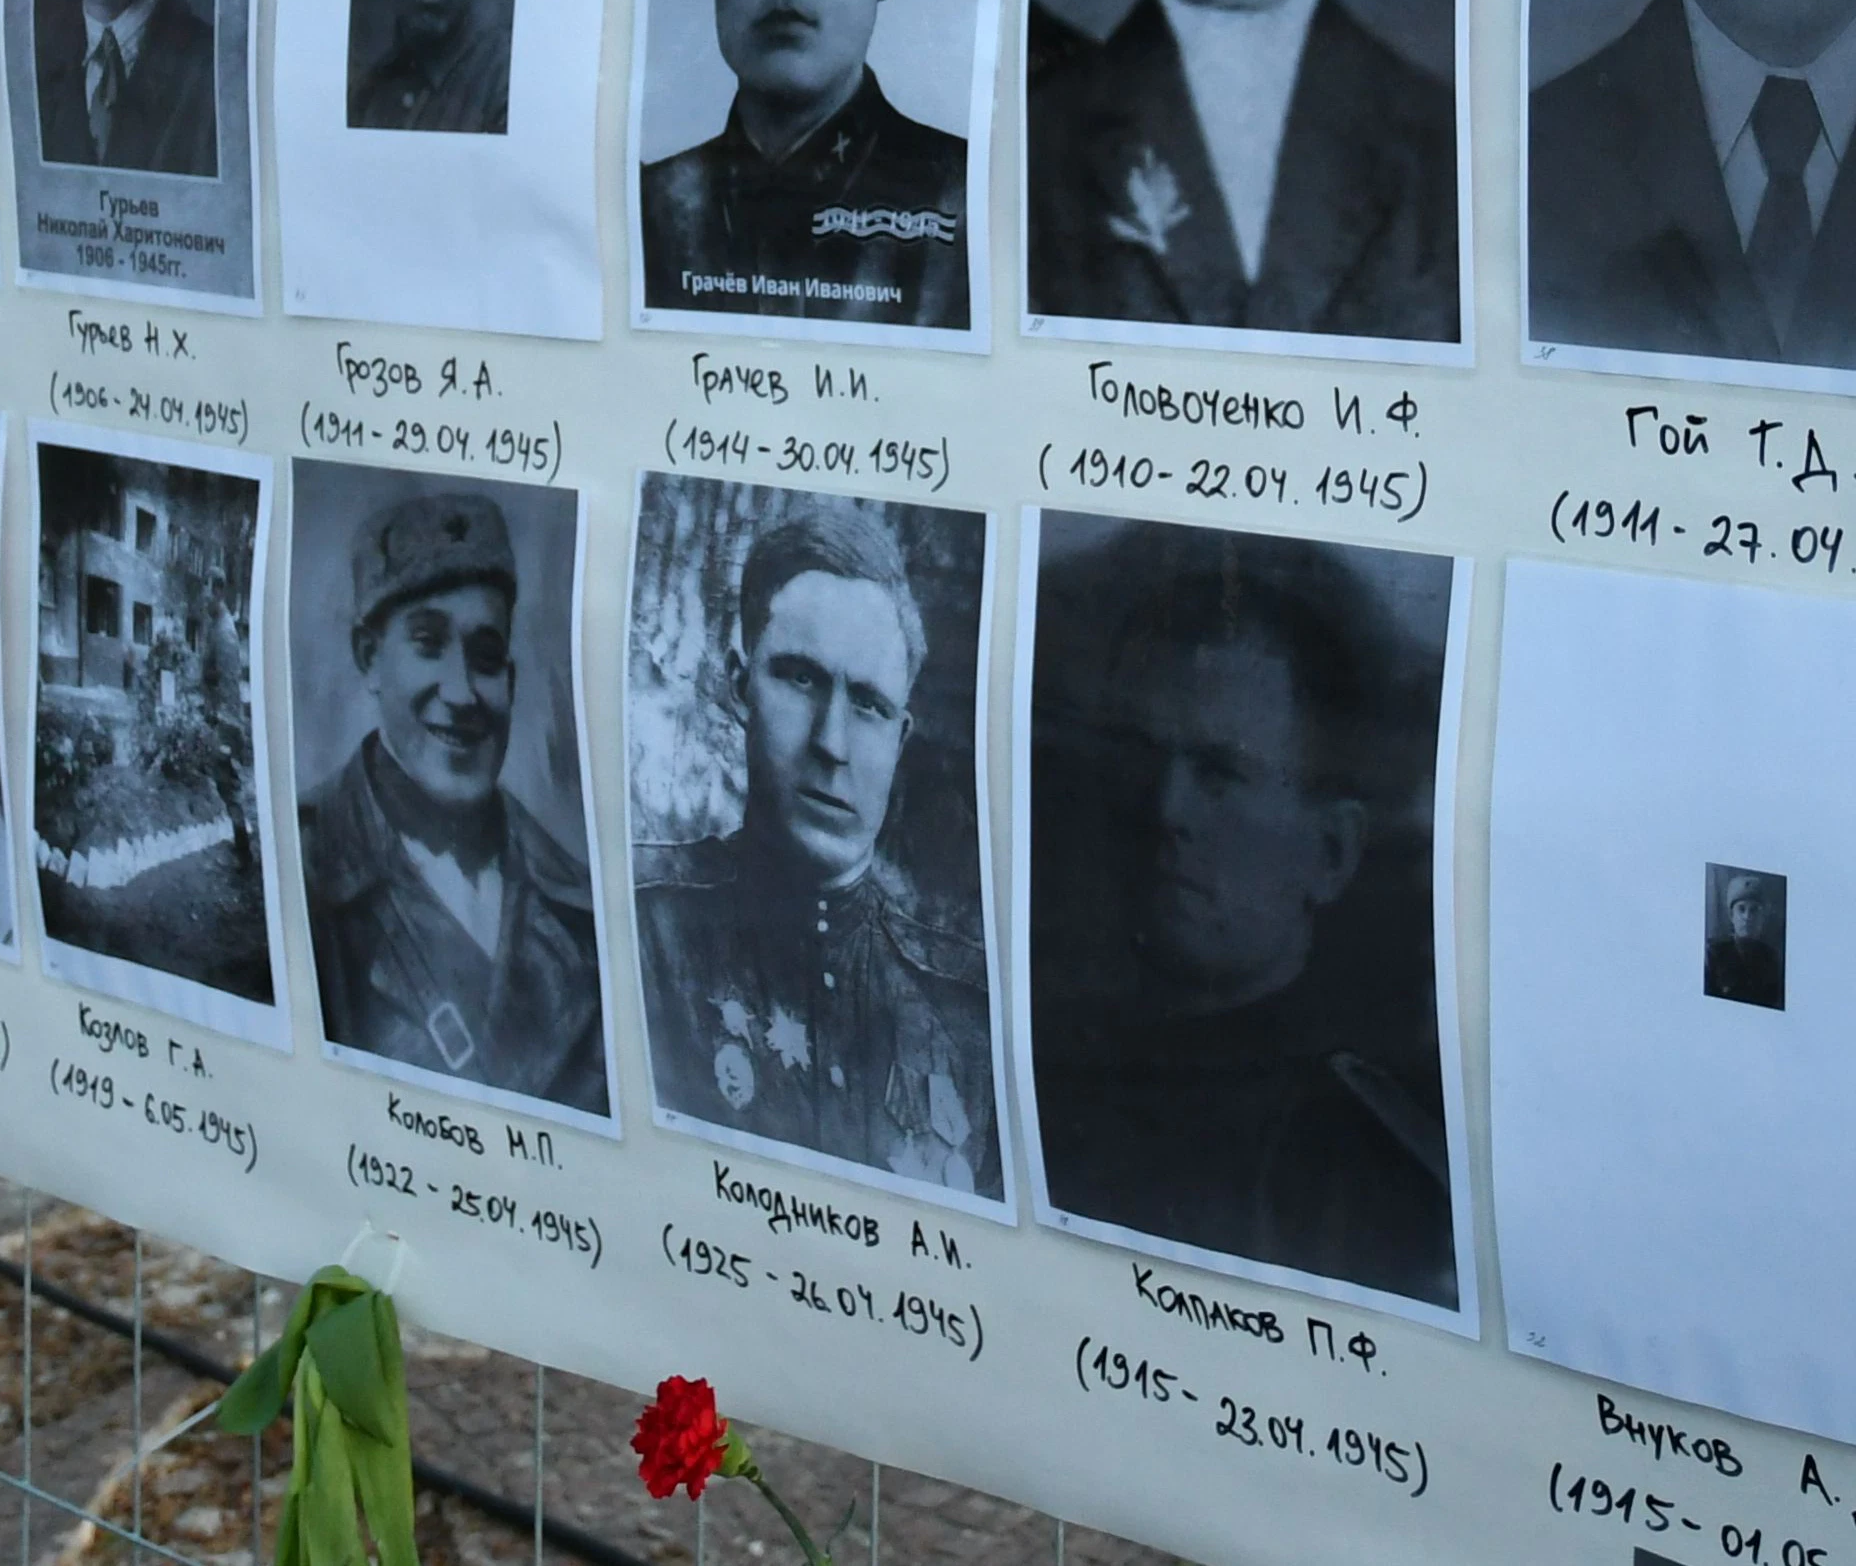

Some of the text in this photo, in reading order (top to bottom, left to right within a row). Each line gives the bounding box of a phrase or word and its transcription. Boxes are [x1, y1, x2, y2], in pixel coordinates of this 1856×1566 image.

[99, 189, 160, 221] Гурьев
[36, 211, 226, 259] Николай Харитонович
[681, 269, 903, 304] Грачёв Иван Иванович
[1625, 405, 1709, 456] Гой
[78, 1002, 150, 1059] Козлов
[1596, 1393, 1744, 1478] Внуков
